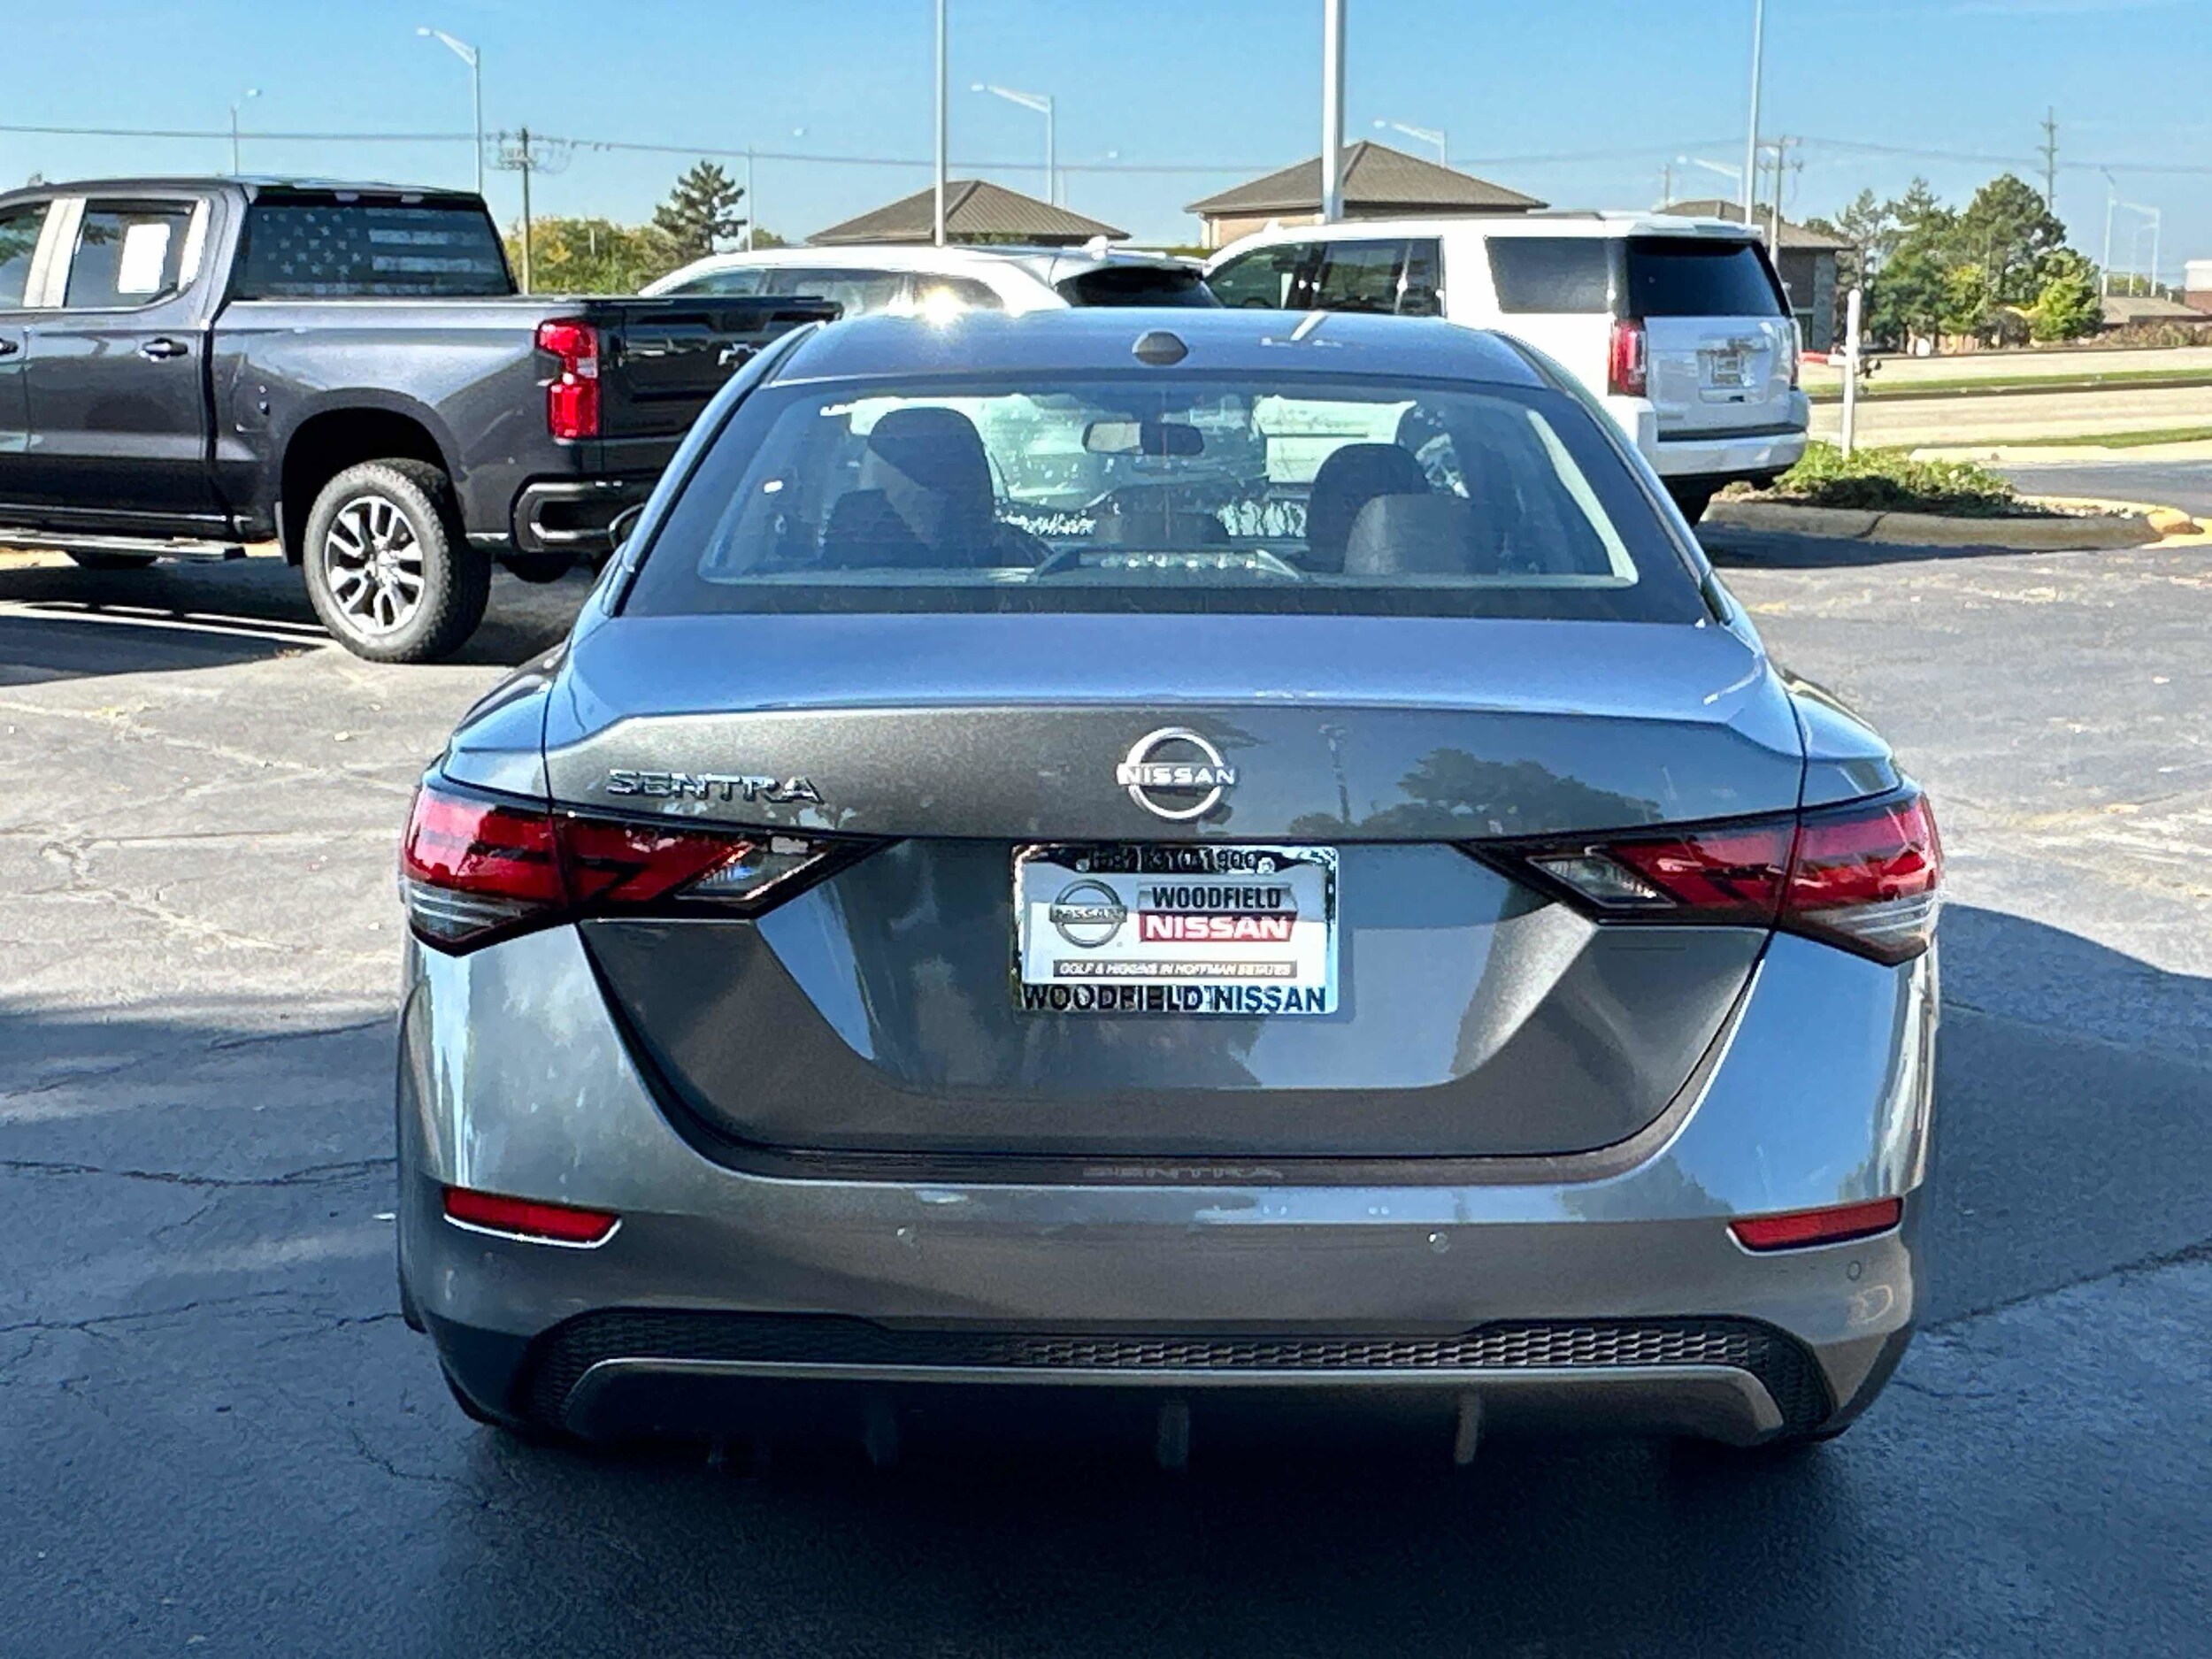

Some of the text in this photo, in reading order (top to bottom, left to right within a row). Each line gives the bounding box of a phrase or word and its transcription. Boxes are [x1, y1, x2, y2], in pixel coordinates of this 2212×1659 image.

[606, 768, 825, 804] SENTRA
[1117, 765, 1235, 786] NISSAN
[1152, 887, 1281, 909] WOODFIELD
[1145, 915, 1288, 940] NISSAN
[1021, 984, 1326, 1011] WOODFIELD NISSAN
